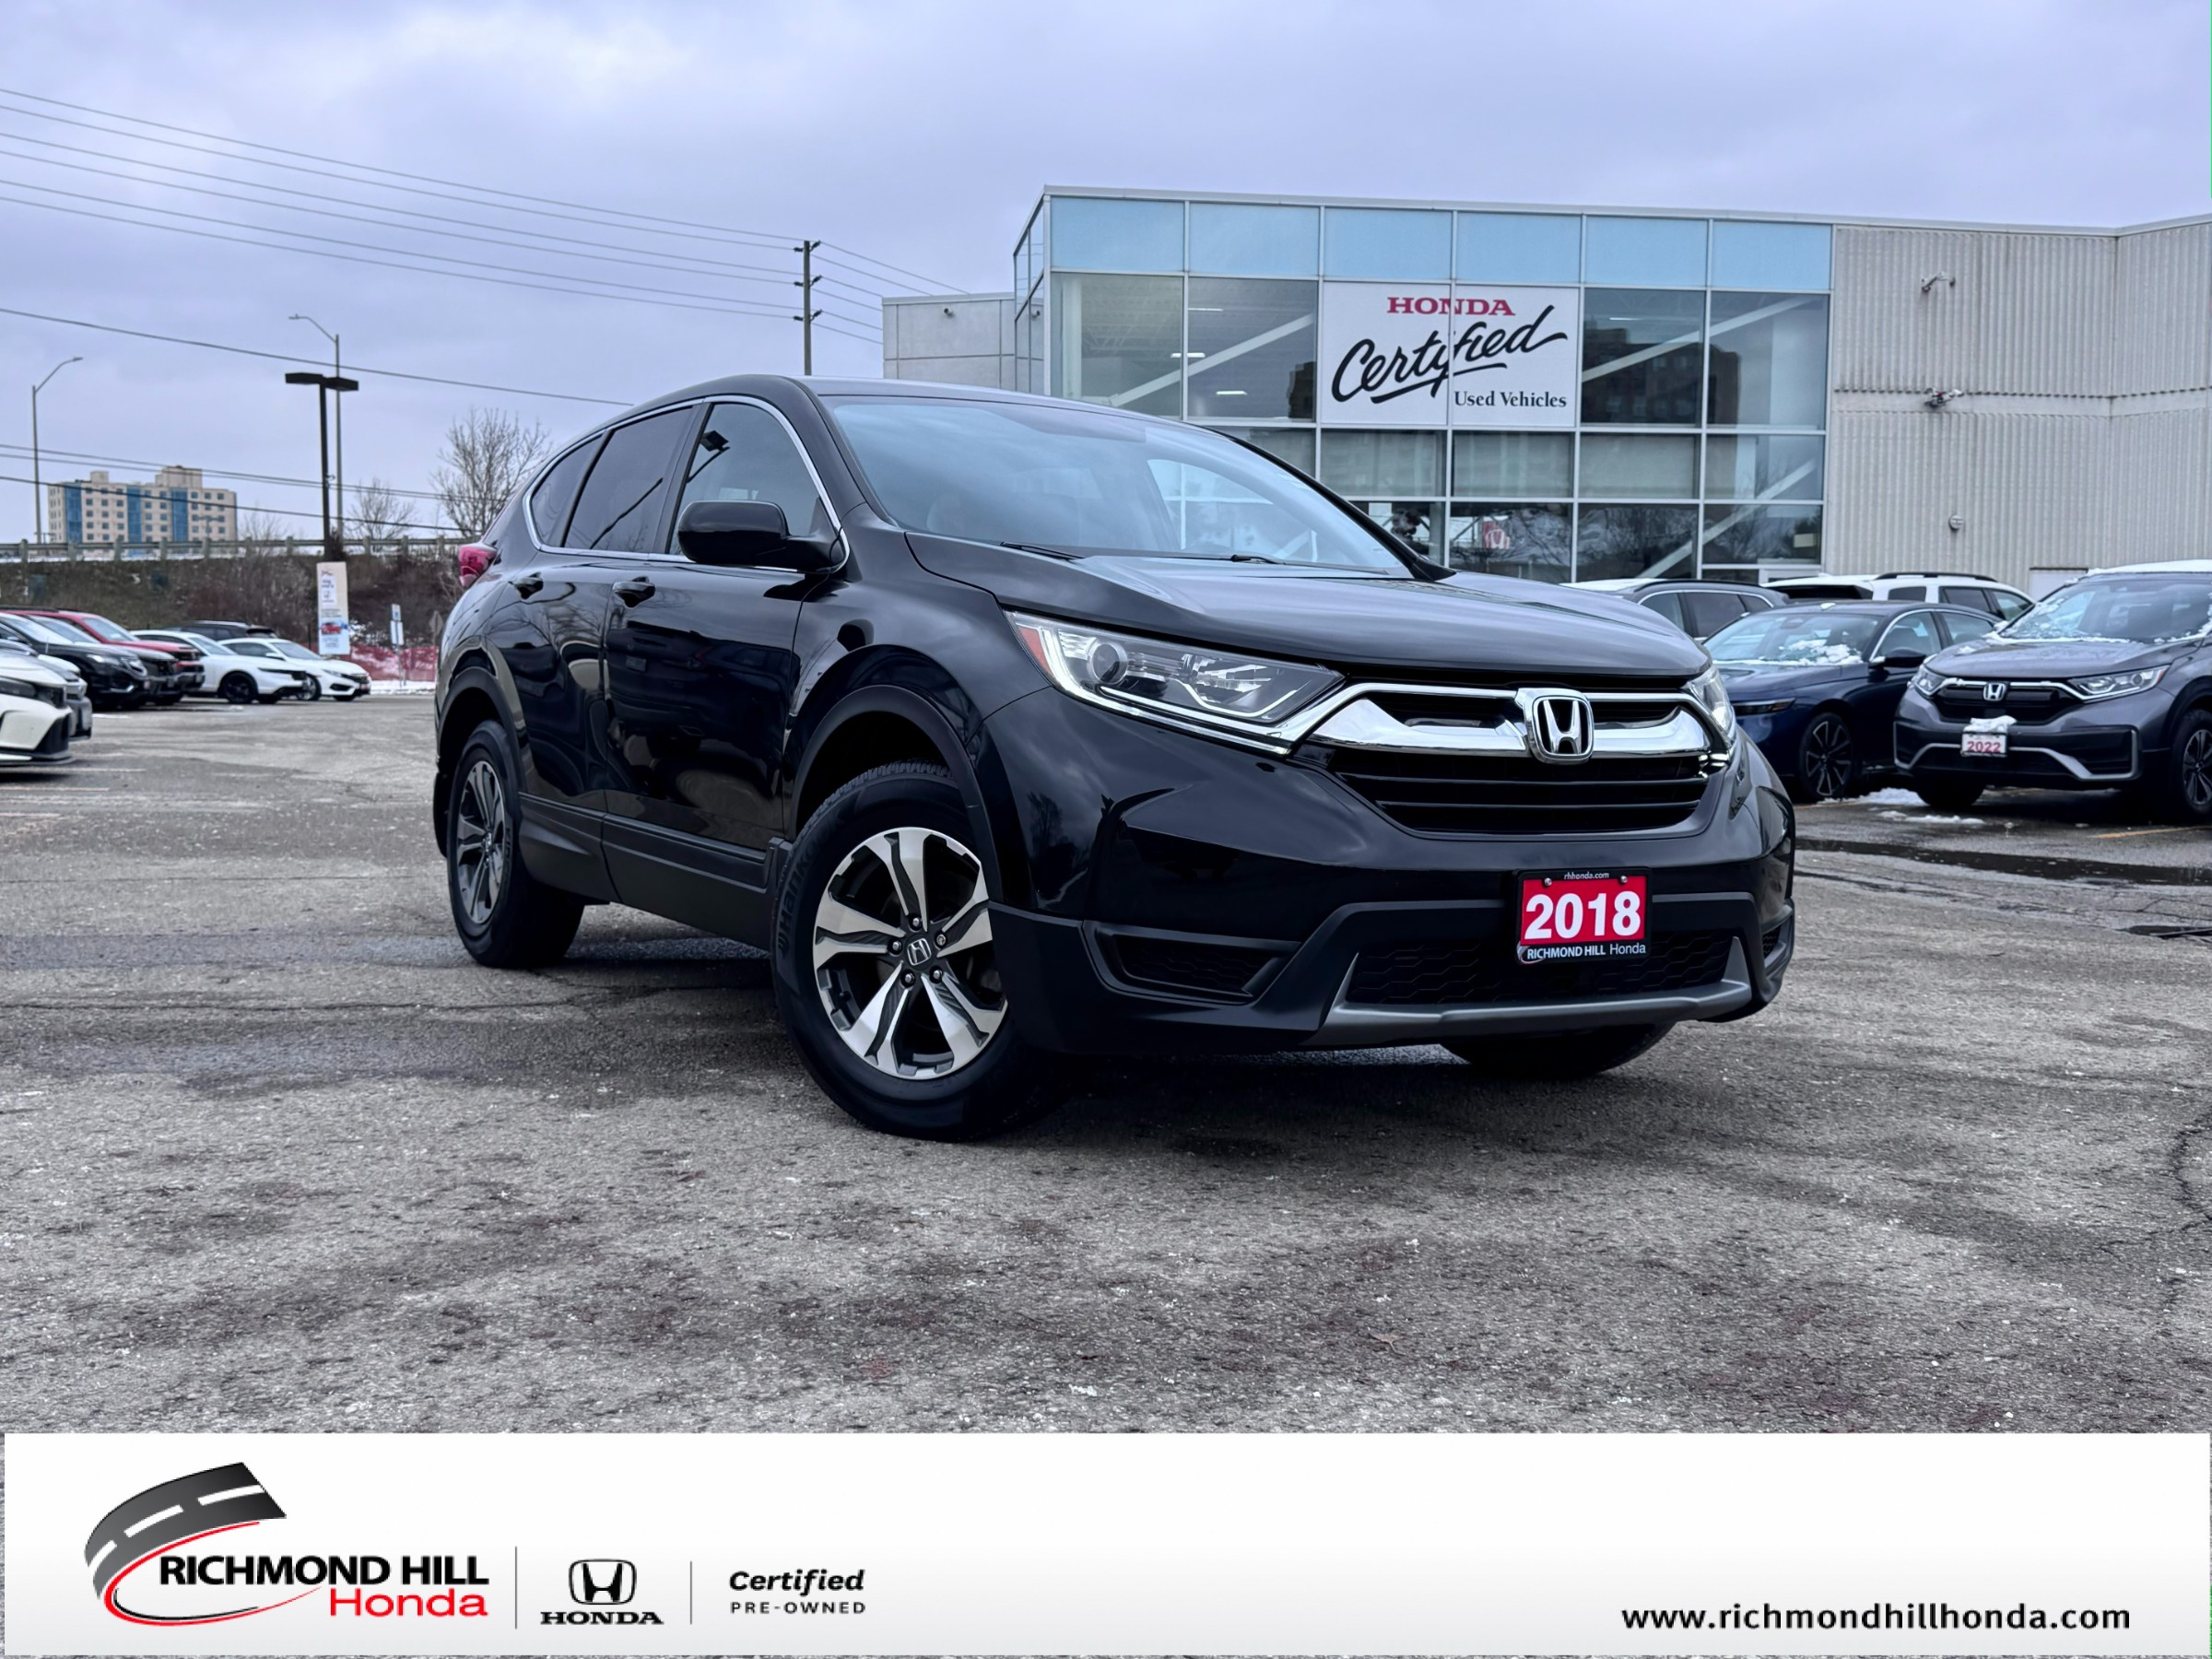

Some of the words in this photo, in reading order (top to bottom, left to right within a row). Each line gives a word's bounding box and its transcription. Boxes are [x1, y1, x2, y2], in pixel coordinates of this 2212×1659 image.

[1387, 297, 1515, 316] HONDA
[1332, 304, 1568, 404] Certified
[1454, 391, 1495, 406] Used
[1500, 392, 1567, 407] Vehicles
[1967, 741, 2001, 754] 2022
[1563, 872, 1610, 880] rhhonda.com
[1524, 890, 1641, 940] 2018
[1526, 947, 1583, 959] RICHMOND
[1584, 945, 1606, 956] HILL
[1609, 942, 1646, 955] Honda
